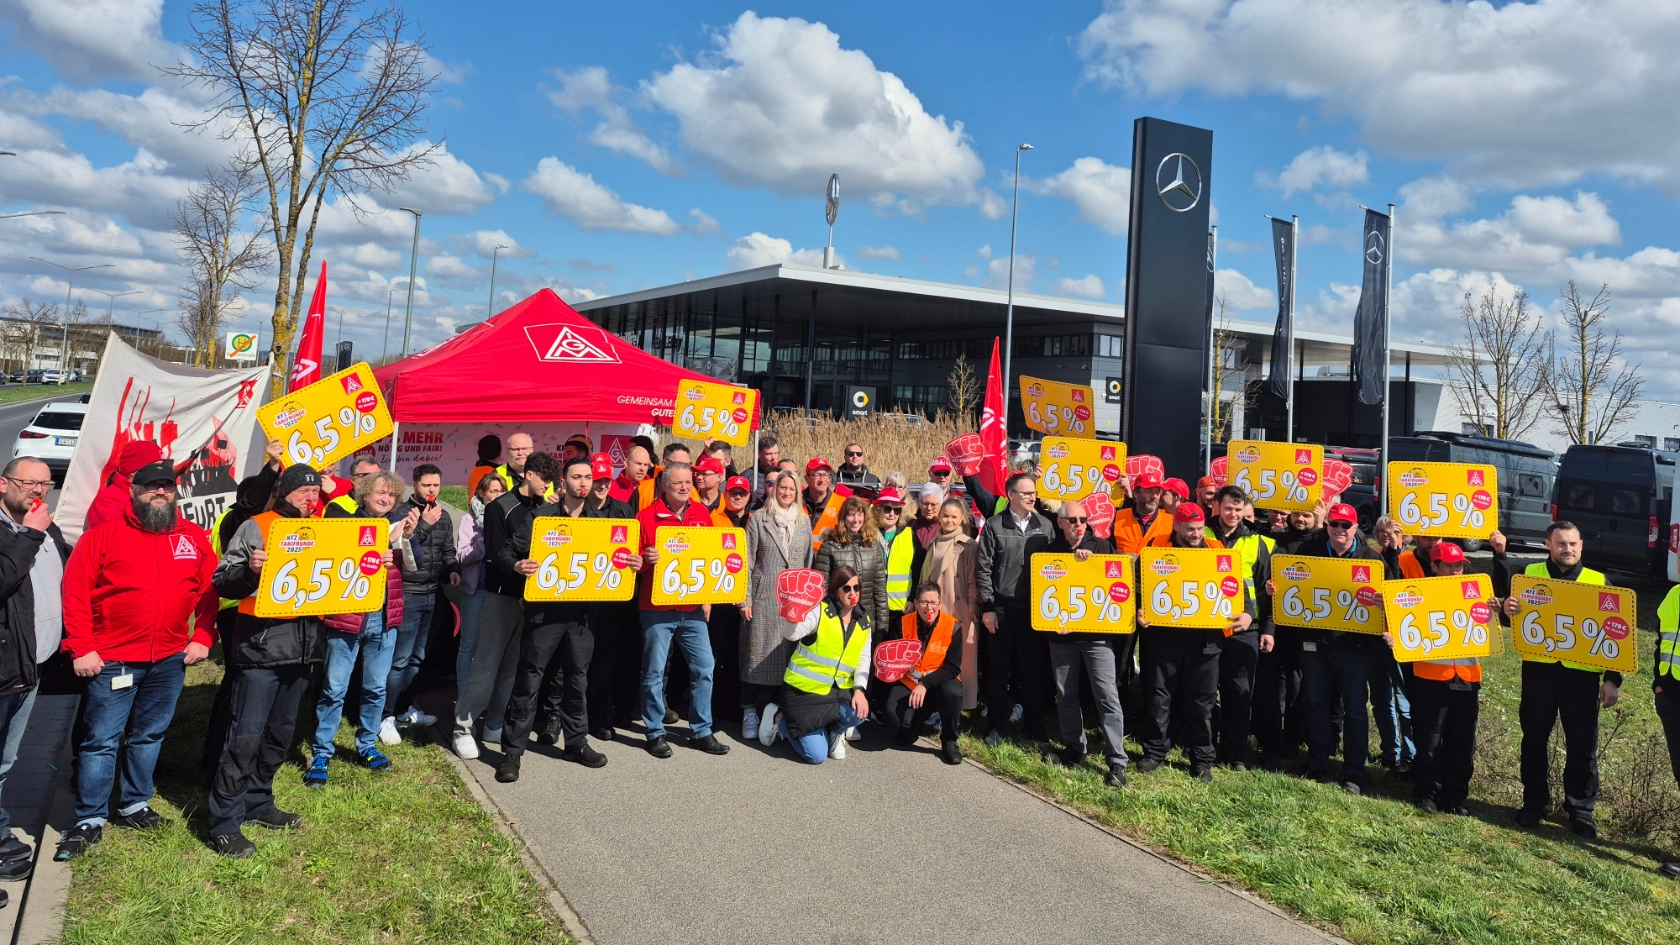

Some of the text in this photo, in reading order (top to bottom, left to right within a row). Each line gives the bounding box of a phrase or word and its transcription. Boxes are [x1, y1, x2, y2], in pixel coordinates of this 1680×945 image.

[617, 395, 672, 407] GEMEINSAM
[652, 408, 676, 417] GUTE
[403, 432, 443, 443] MEHR
[182, 496, 225, 530] FURT
[1521, 594, 1552, 602] TARIFRUNDE
